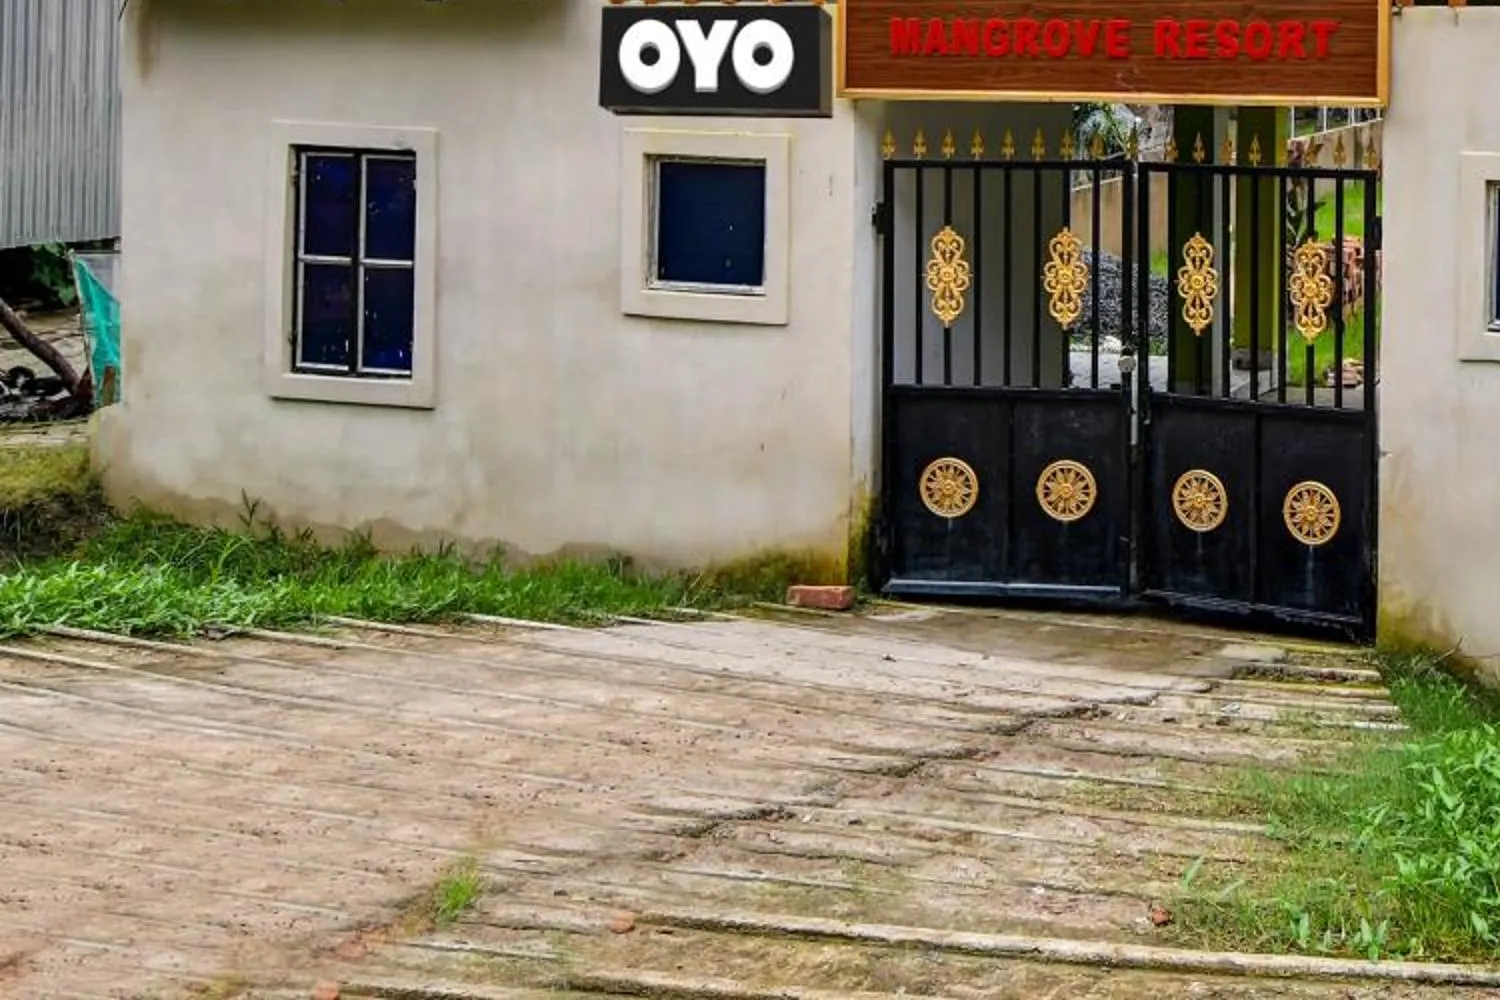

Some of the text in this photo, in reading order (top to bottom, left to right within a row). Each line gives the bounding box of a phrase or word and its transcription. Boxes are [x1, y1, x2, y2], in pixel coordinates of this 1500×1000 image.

[618, 18, 795, 94] OYO
[889, 15, 1340, 60] MANGROVE RESORT
